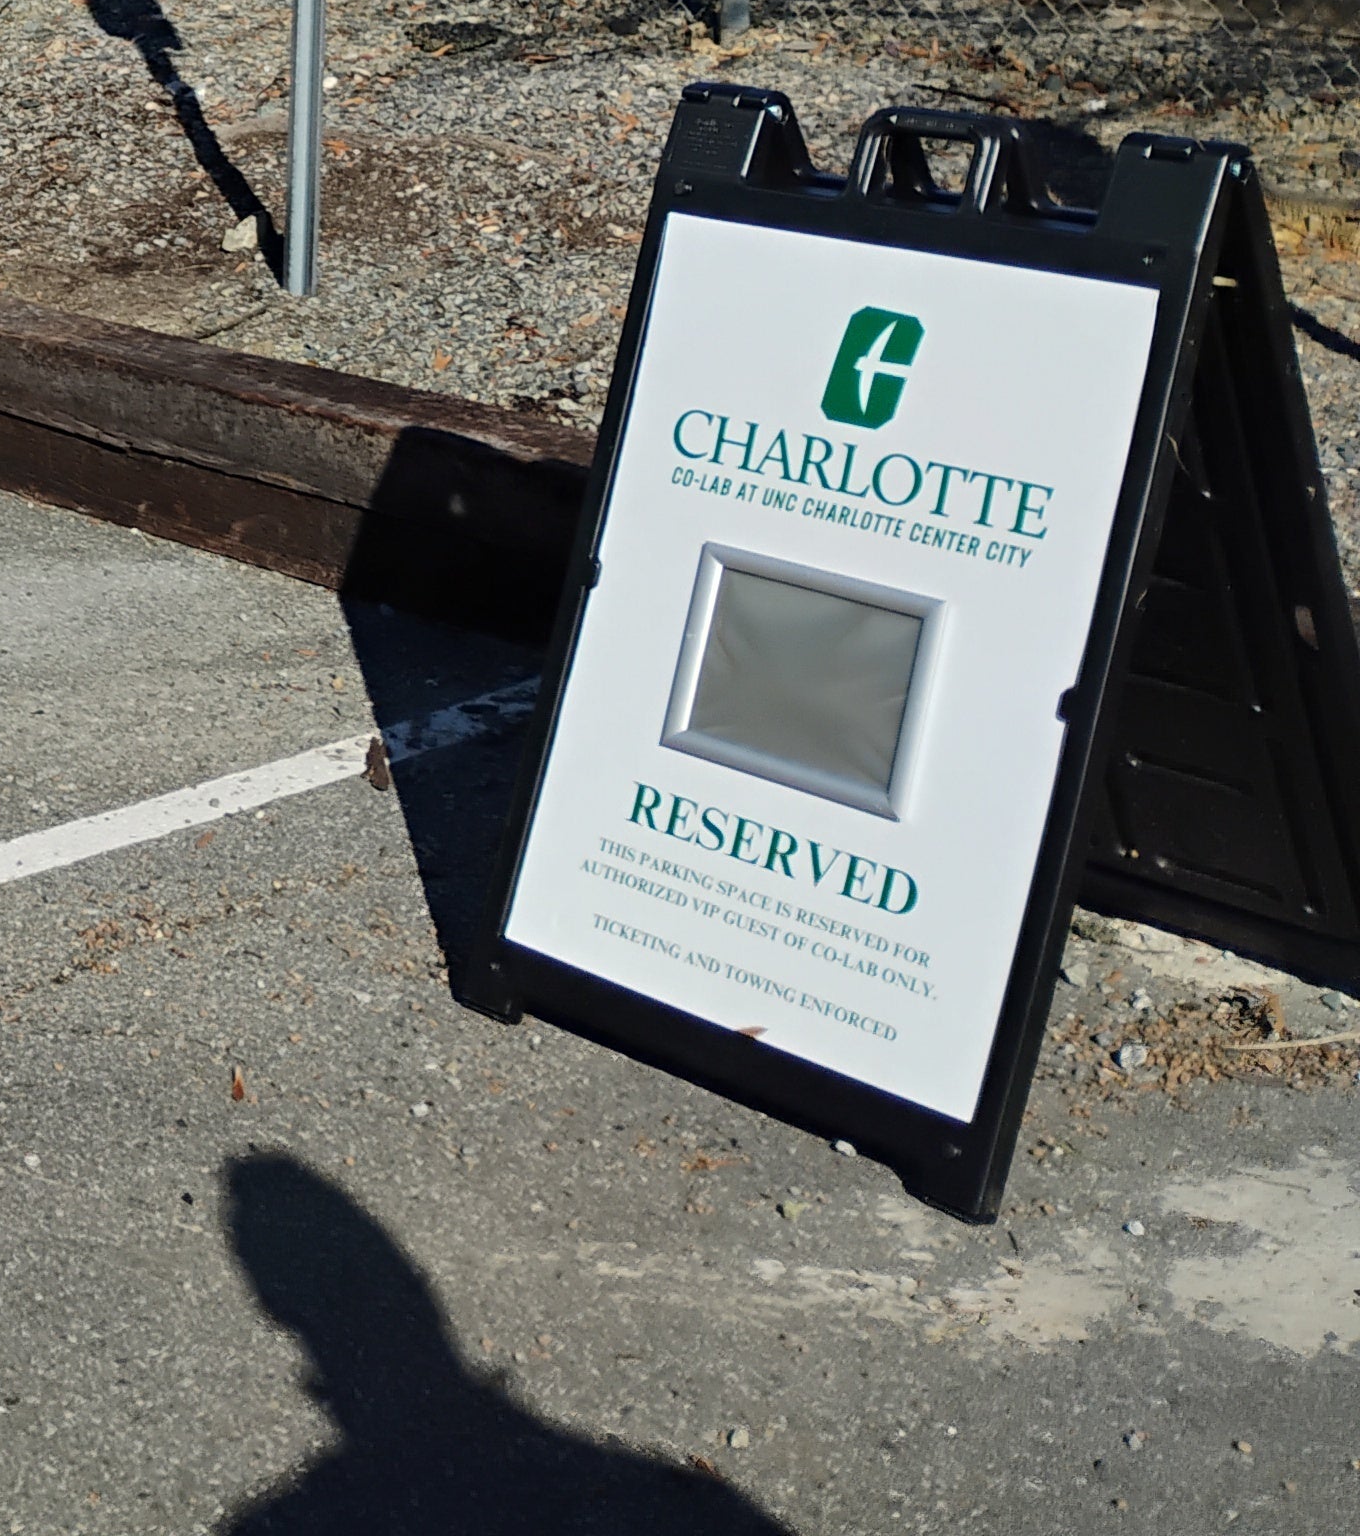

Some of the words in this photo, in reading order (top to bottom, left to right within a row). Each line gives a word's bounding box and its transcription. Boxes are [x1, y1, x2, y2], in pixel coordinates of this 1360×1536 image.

[671, 467, 732, 497] CO-LAB
[736, 483, 760, 503] AT
[762, 488, 798, 512] UNC
[802, 498, 906, 539] CHARLOTTE
[910, 523, 981, 556] CENTER
[986, 542, 1033, 568] CITY
[673, 410, 1054, 539] CHARLOTTE
[599, 837, 636, 863] THIS
[638, 852, 713, 889] PARKING
[716, 880, 772, 912] SPACE
[775, 900, 792, 918] IS
[794, 908, 889, 953] RESERVED
[892, 943, 931, 968] FOR
[625, 782, 919, 915] RESERVED
[580, 860, 688, 908] AUTHORIZED
[692, 897, 721, 920] VIP
[723, 911, 782, 942] GUEST
[784, 932, 809, 951] OF
[812, 942, 878, 977] CO-LAB
[882, 967, 938, 1001] ONLY.
[593, 914, 681, 959] TICKETING
[684, 951, 721, 974] AND
[724, 965, 796, 1004] TOWING
[800, 993, 898, 1042] ENFORCED
